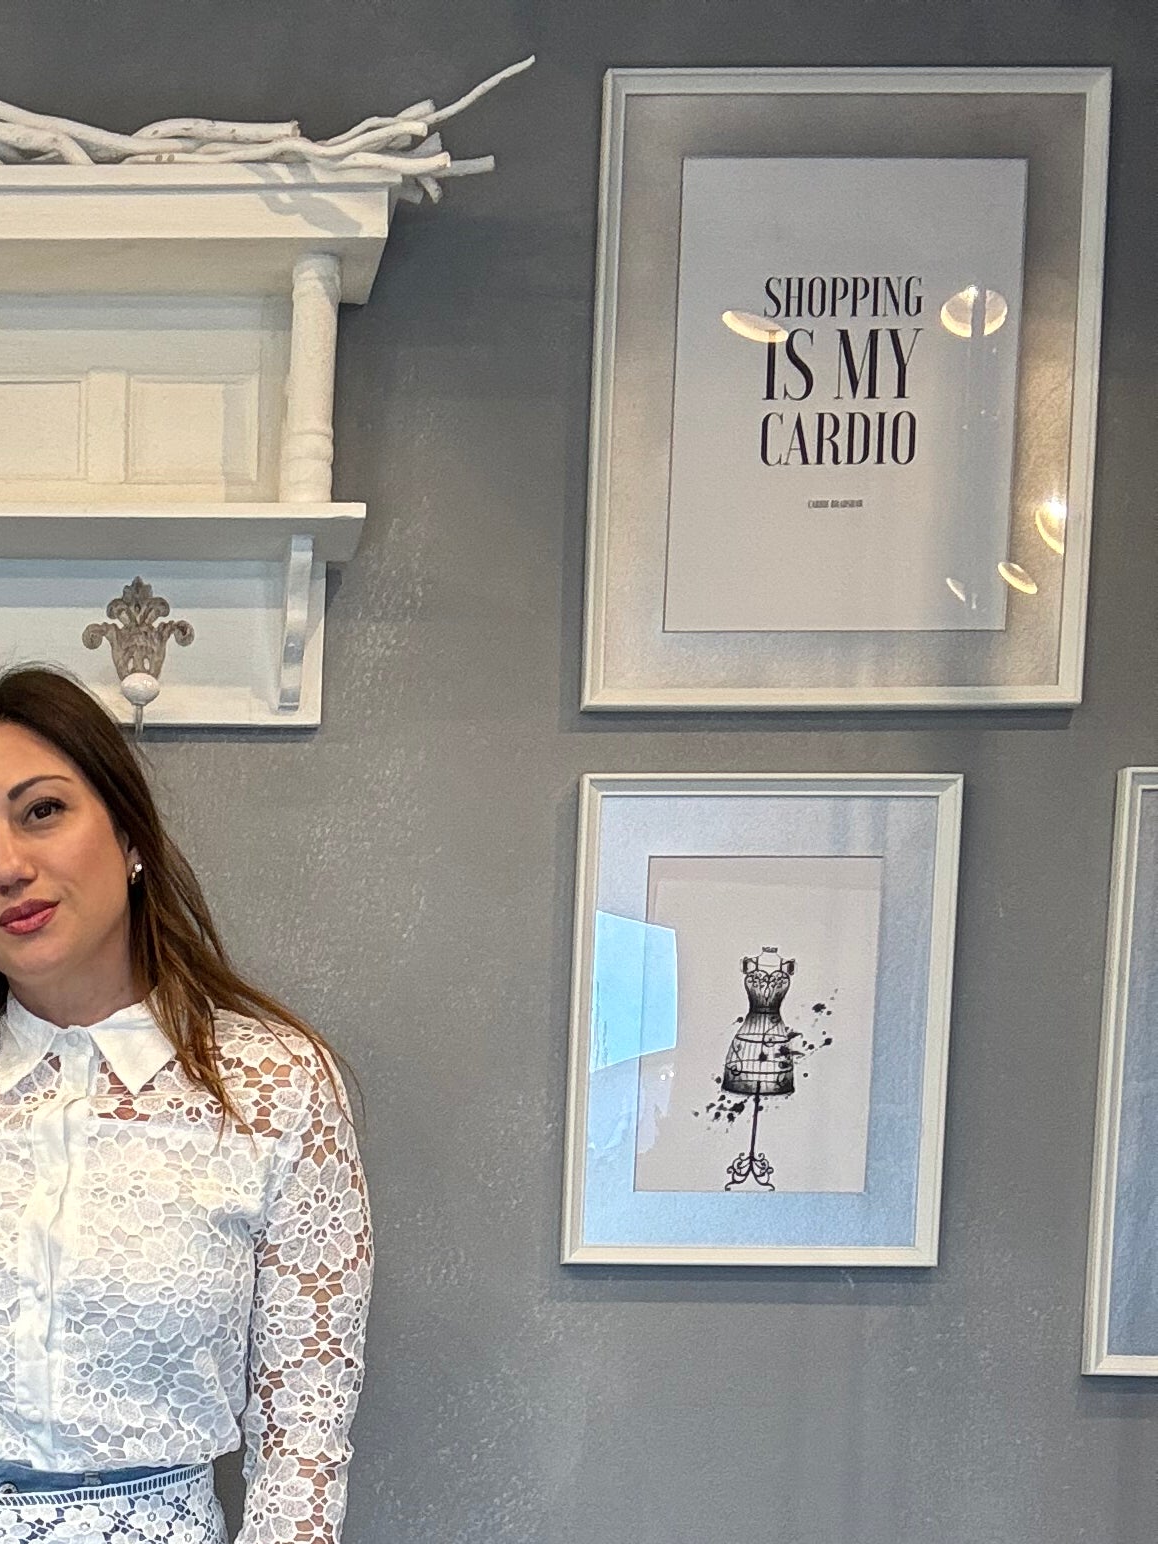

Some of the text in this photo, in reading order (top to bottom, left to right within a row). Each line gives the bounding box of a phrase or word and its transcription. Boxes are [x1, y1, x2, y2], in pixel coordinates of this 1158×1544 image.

[763, 276, 924, 318] SHOPPING
[762, 327, 924, 401] IS MY
[760, 410, 917, 467] CARDIO
